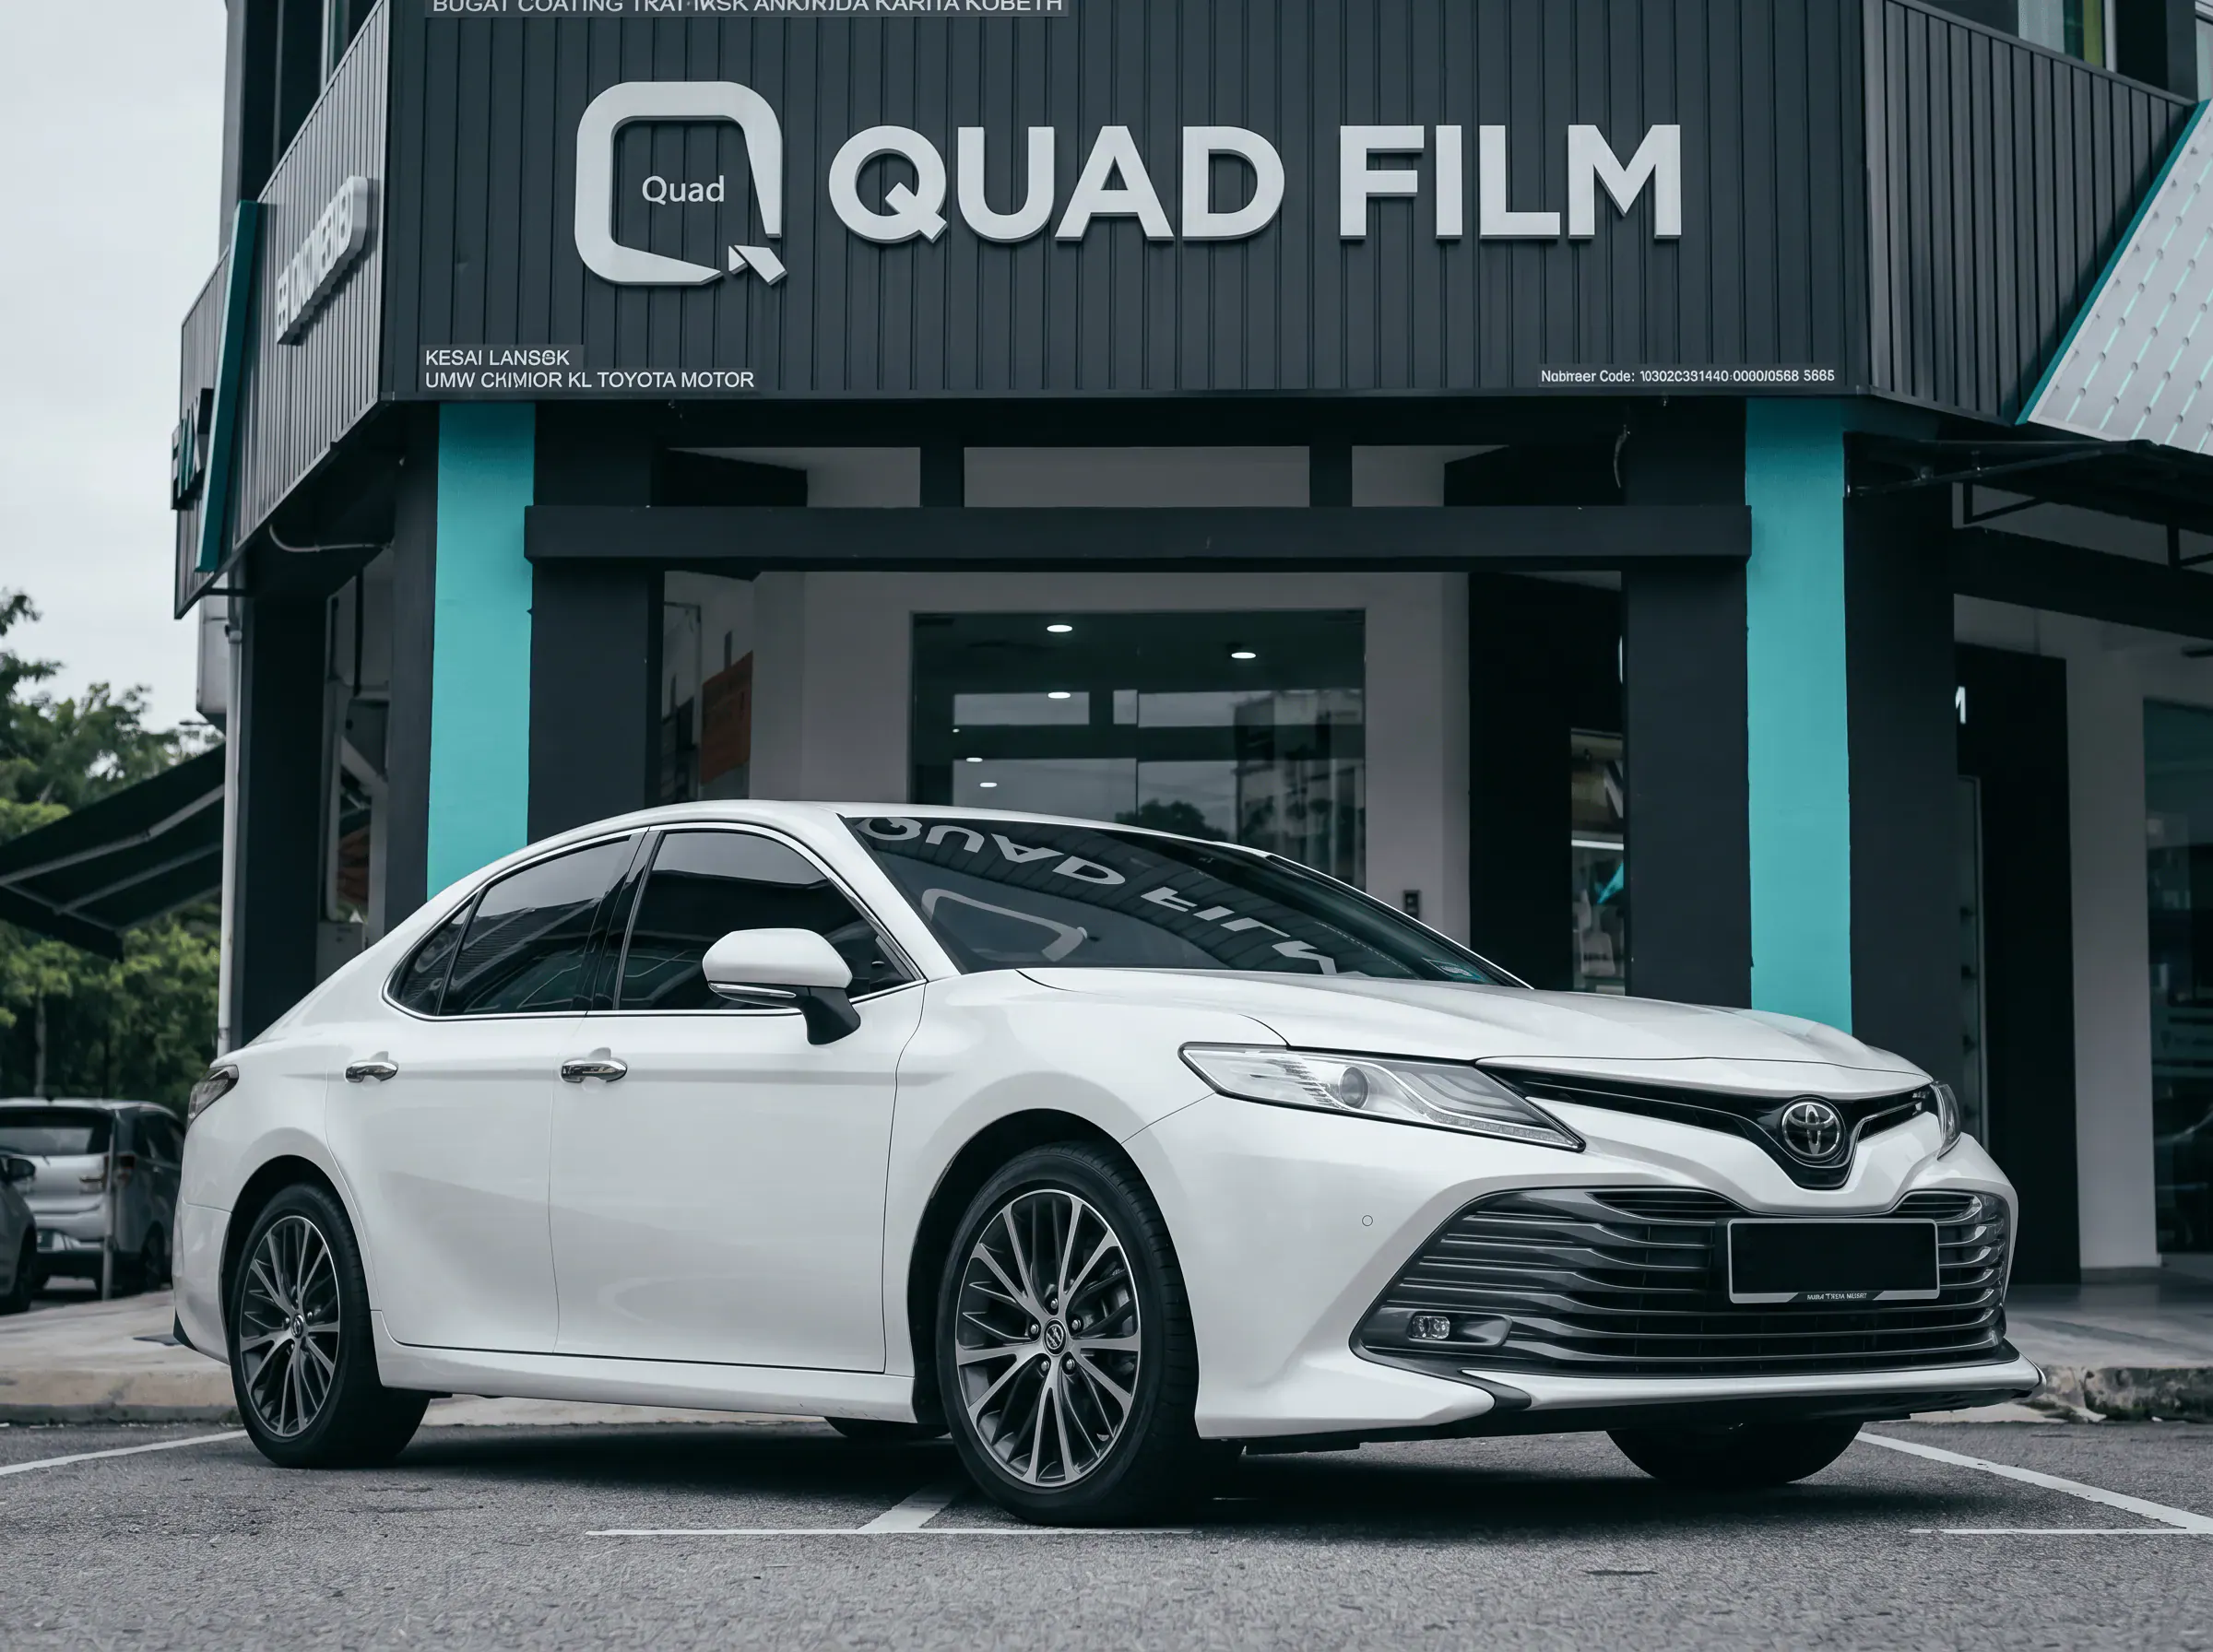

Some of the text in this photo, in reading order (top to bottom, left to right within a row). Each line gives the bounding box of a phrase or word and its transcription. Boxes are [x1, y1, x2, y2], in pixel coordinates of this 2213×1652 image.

[517, 0, 623, 12] COATING
[642, 175, 725, 206] Quad
[828, 124, 1682, 243] QUAD FILM
[425, 349, 482, 366] KESAI
[425, 372, 476, 388] UMW
[568, 372, 593, 388] KL
[597, 371, 677, 388] TOYOTA
[681, 371, 755, 388] MOTOR
[1599, 370, 1635, 383] Code:
